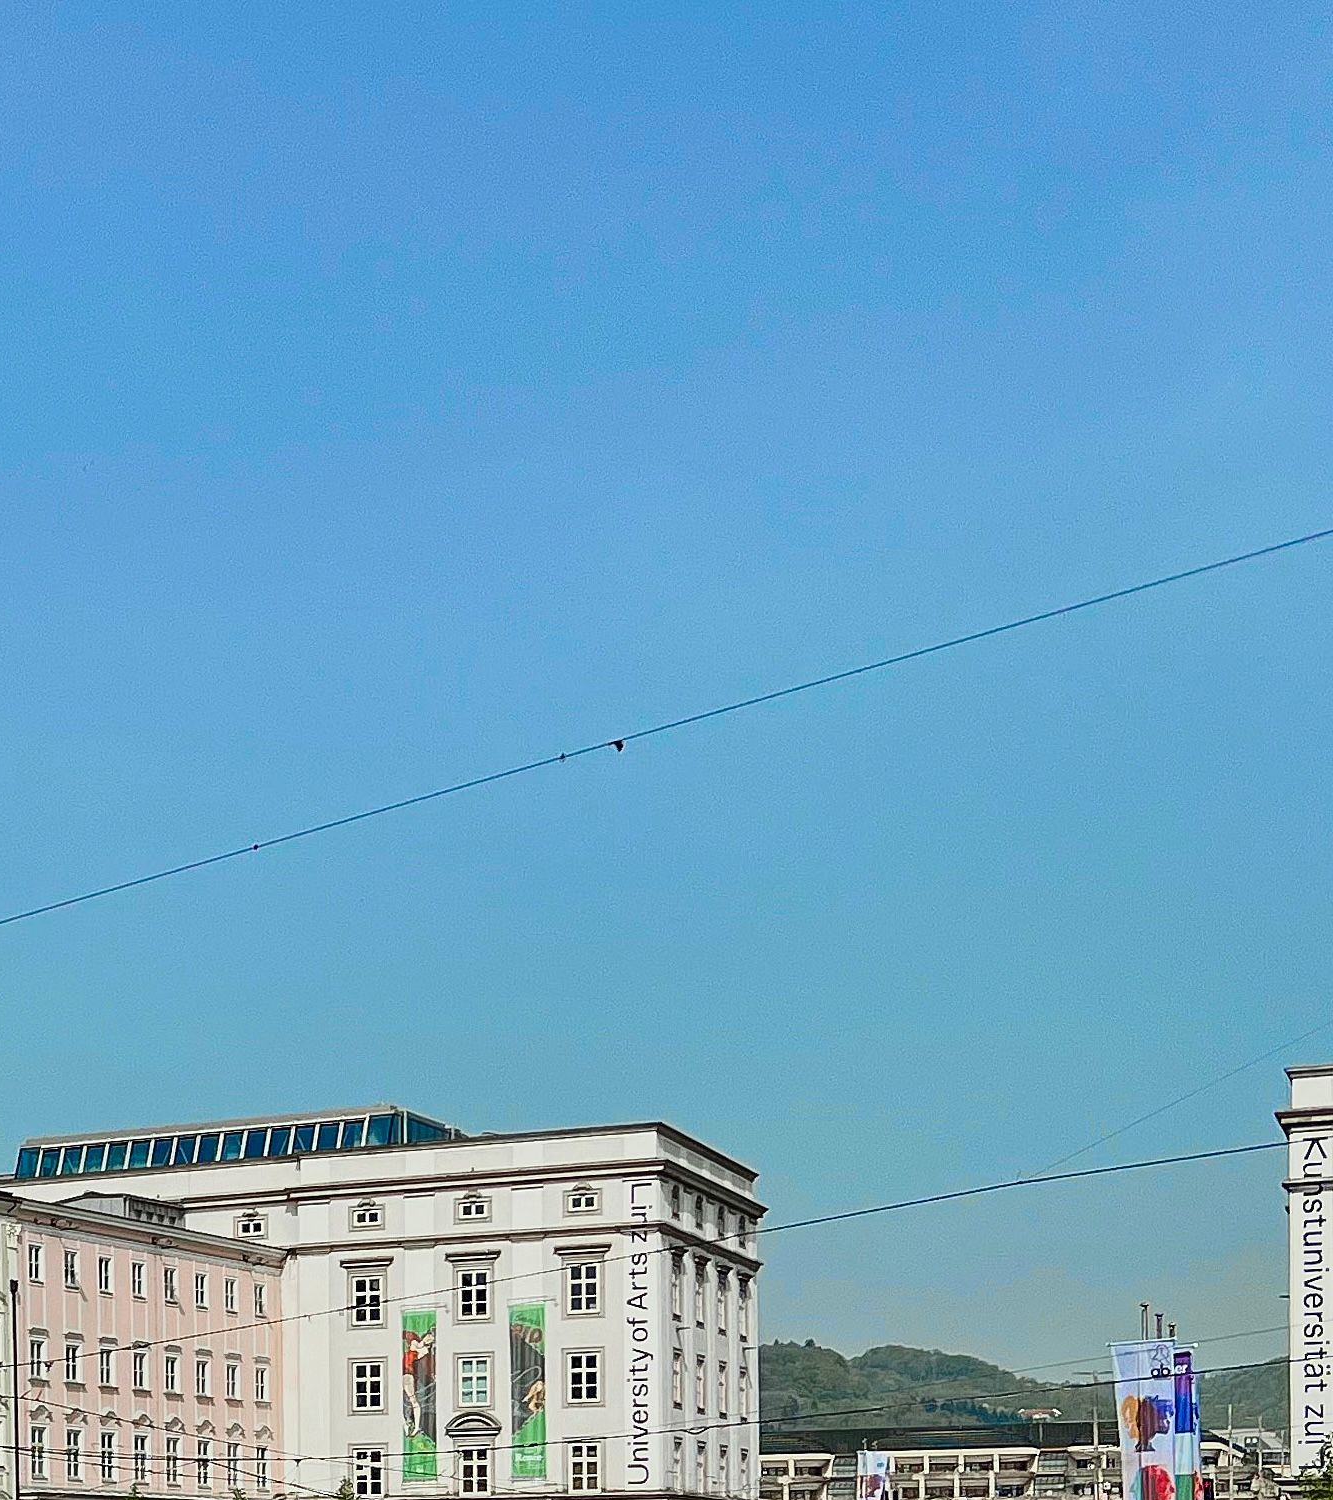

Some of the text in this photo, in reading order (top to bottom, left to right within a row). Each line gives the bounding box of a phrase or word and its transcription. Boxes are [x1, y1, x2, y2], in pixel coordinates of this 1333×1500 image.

[627, 1182, 653, 1485] University of Arts Linz
[1302, 1137, 1331, 1393] Kunstuniversität
